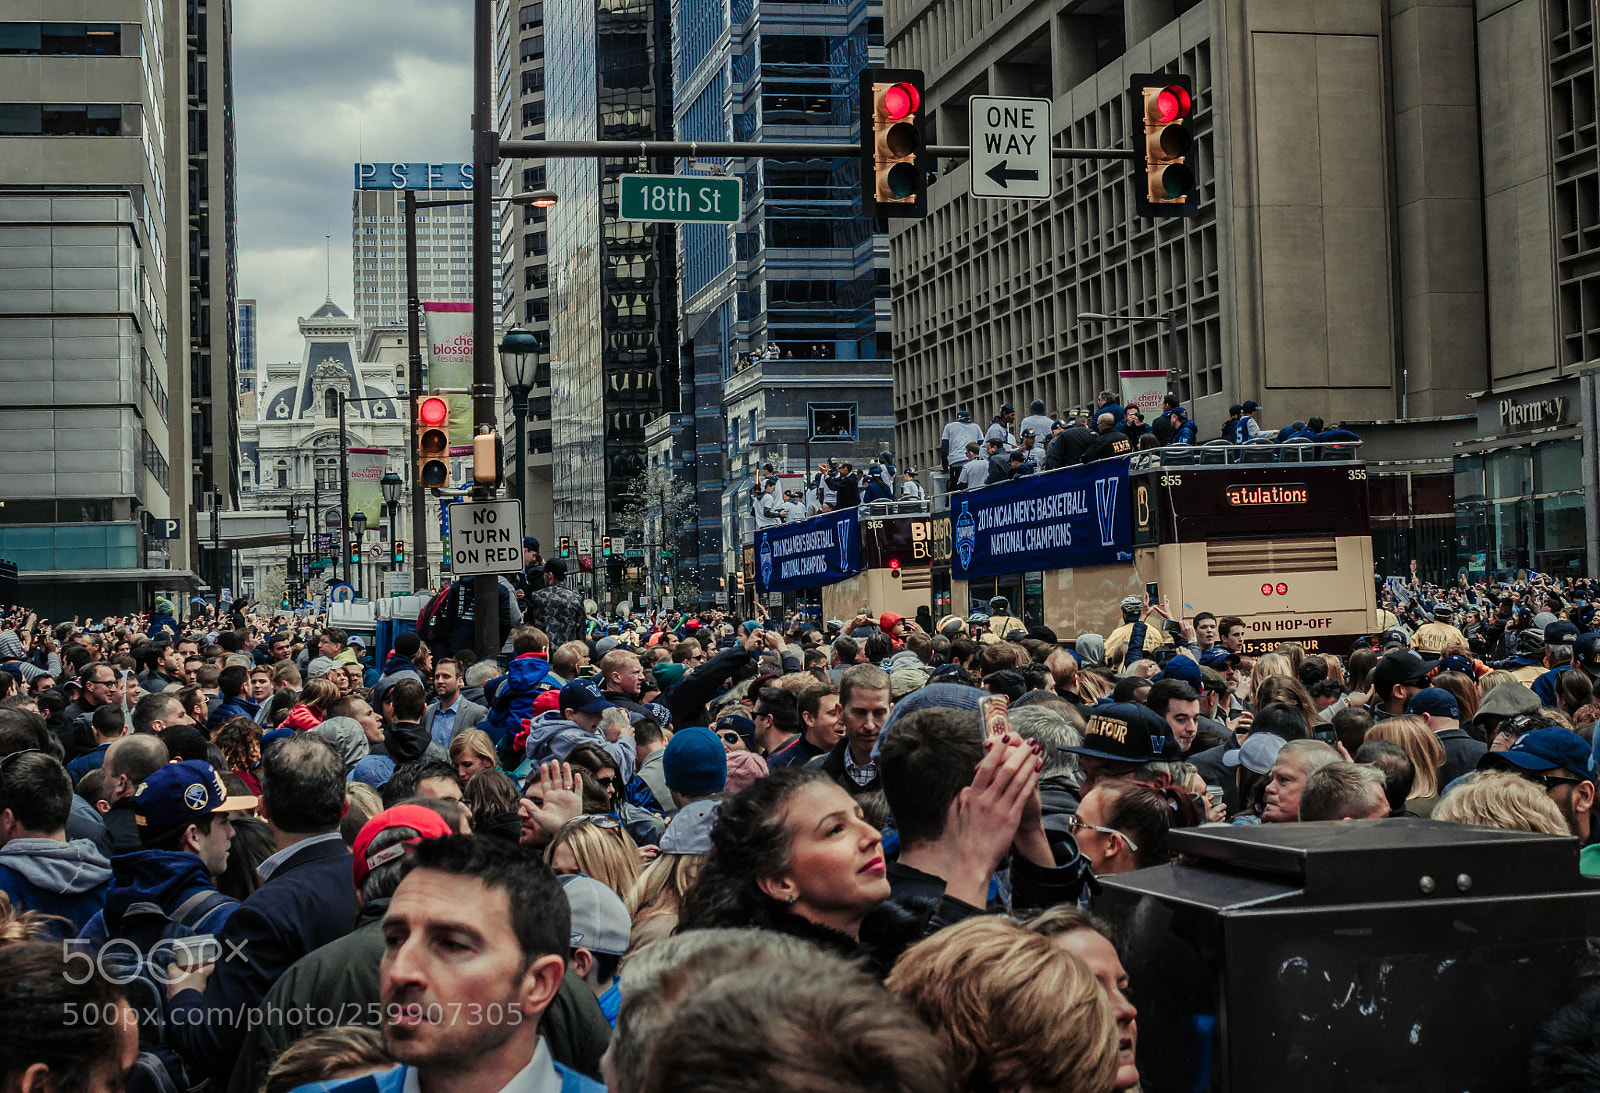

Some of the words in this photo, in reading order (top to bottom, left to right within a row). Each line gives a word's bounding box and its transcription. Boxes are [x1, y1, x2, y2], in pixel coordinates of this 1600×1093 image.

[987, 106, 1034, 128] ONE
[984, 133, 1036, 155] WAY
[359, 163, 474, 188] PSFS
[640, 186, 690, 212] 18th
[698, 187, 720, 212] St
[454, 335, 473, 345] che
[1138, 394, 1162, 402] cherry
[1499, 396, 1564, 426] Pharmacy
[1160, 475, 1182, 486] 355
[1348, 469, 1366, 480] 355
[473, 510, 497, 524] NO
[978, 508, 993, 531] 2016
[994, 504, 1013, 528] NCAA
[1013, 499, 1036, 523] MEN'S
[1037, 490, 1088, 520] BASKETBALL
[166, 520, 177, 537] P
[867, 520, 884, 530] 365
[911, 521, 931, 541] BI
[933, 518, 944, 540] BIG
[462, 528, 510, 544] TURN
[806, 529, 834, 550] BASKETBALL
[990, 530, 1025, 556] NATIONAL
[1026, 522, 1072, 550] CHAMPIONS
[456, 549, 479, 564] ON
[485, 547, 519, 562] RED
[1275, 618, 1332, 630] HOP-OFF
[1429, 634, 1447, 642] PHILA
[1100, 720, 1128, 744] FOUR
[1150, 734, 1165, 753] V
